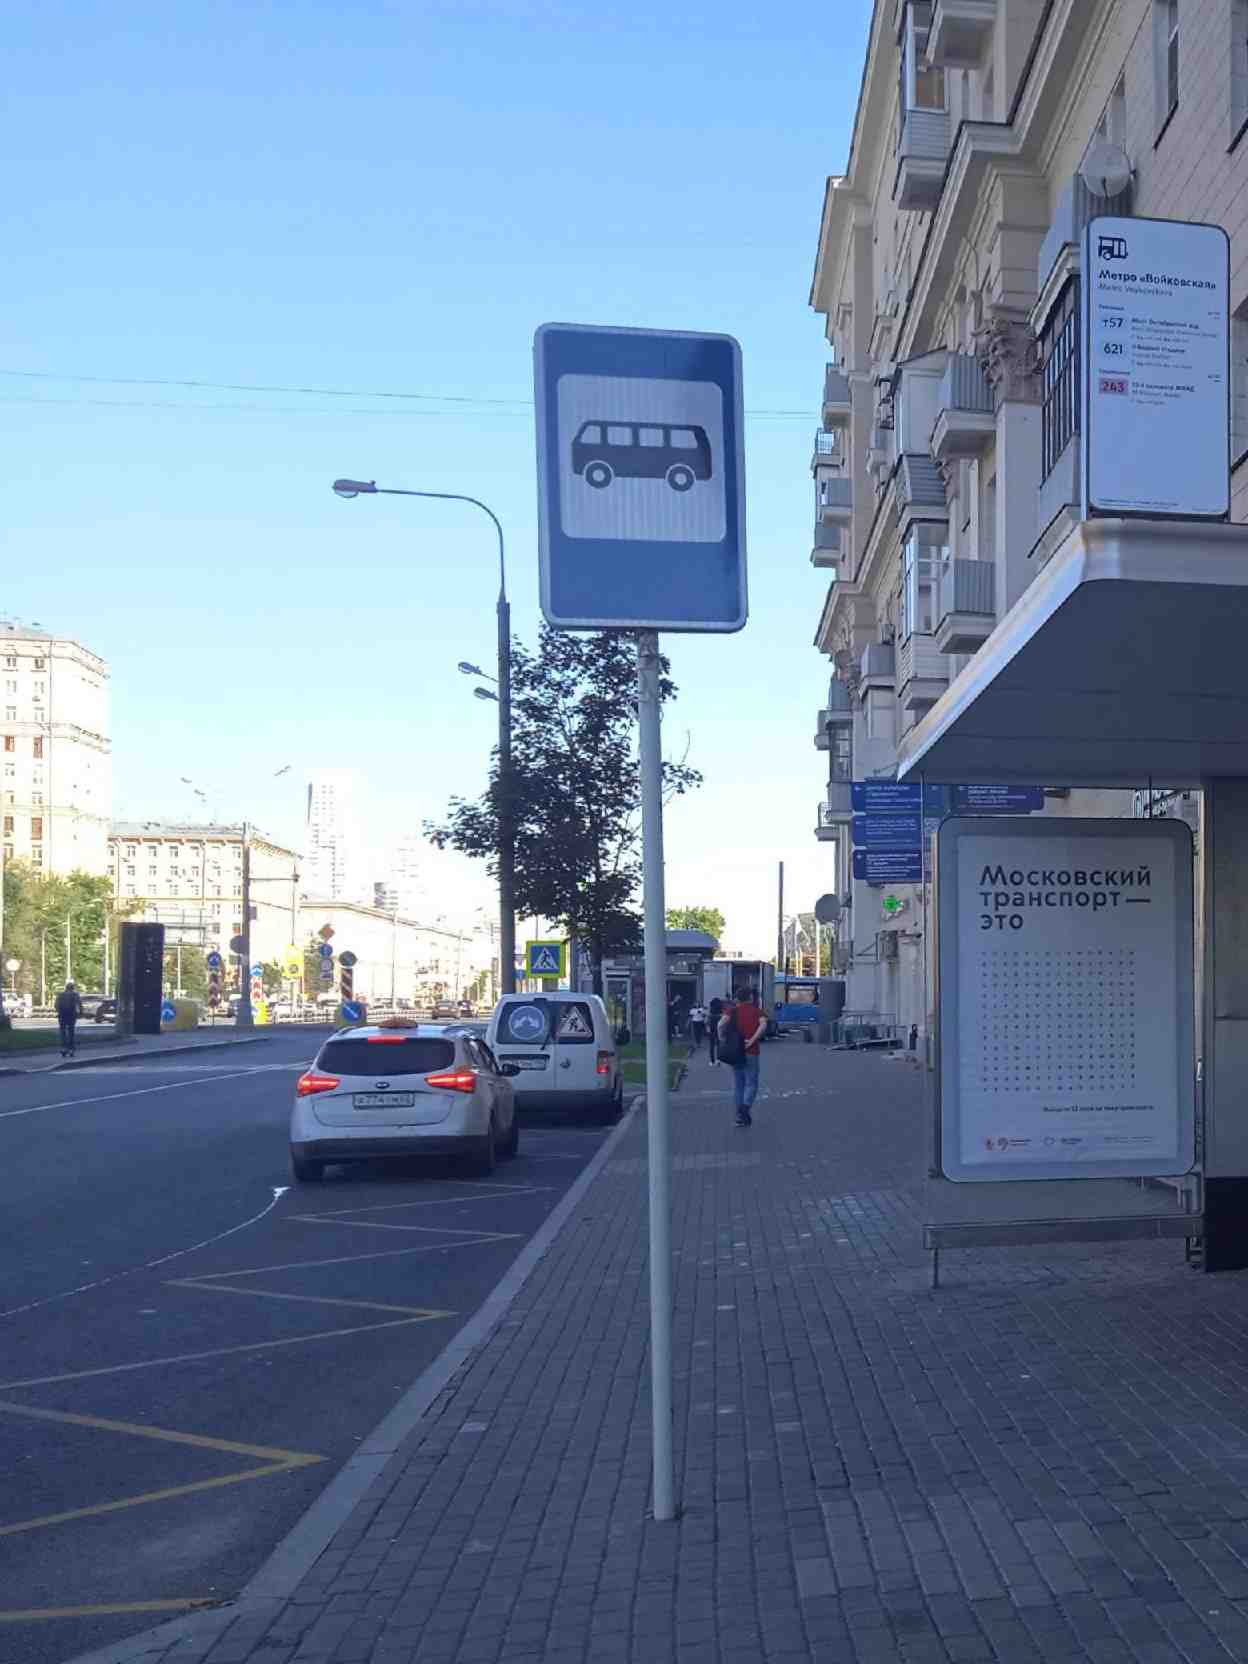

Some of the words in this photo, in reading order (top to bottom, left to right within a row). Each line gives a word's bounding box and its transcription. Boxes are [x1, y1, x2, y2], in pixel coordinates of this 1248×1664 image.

[1099, 269, 1137, 283] Метро
[1103, 343, 1124, 354] 621
[979, 864, 1151, 887] Московский
[980, 891, 1121, 912] транспорт
[980, 913, 1024, 931] это
